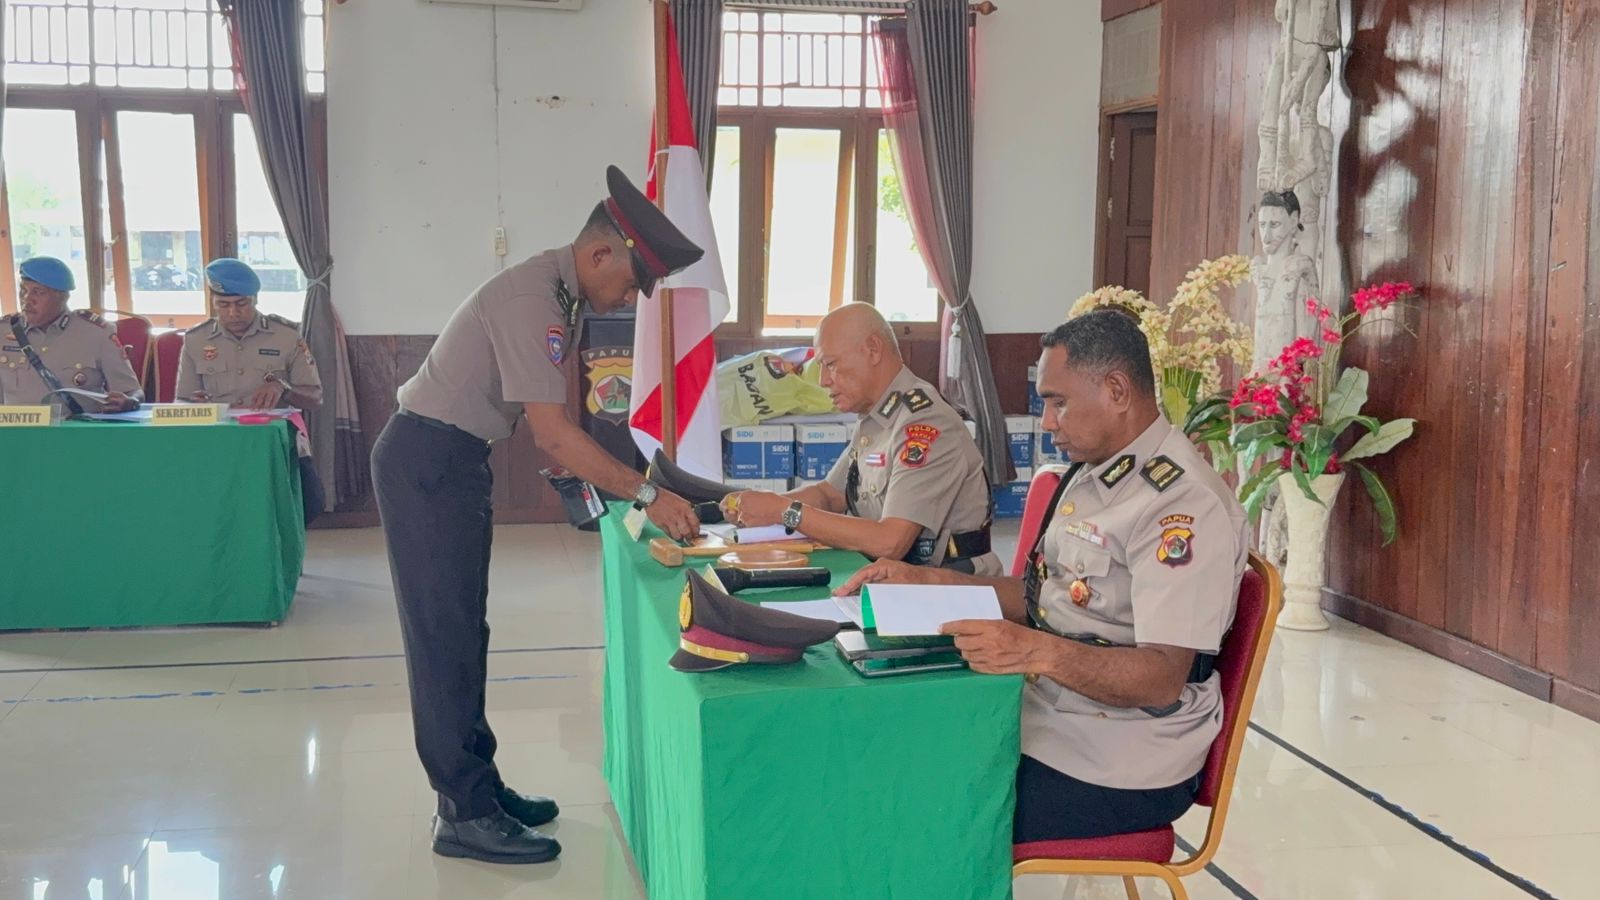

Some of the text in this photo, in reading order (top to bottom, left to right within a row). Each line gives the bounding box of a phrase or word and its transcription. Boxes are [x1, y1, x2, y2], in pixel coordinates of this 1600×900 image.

[587, 349, 630, 360] PAPU
[156, 408, 212, 418] SEKRETARIS
[908, 425, 936, 434] POLDA
[1161, 515, 1191, 525] PAPUA
